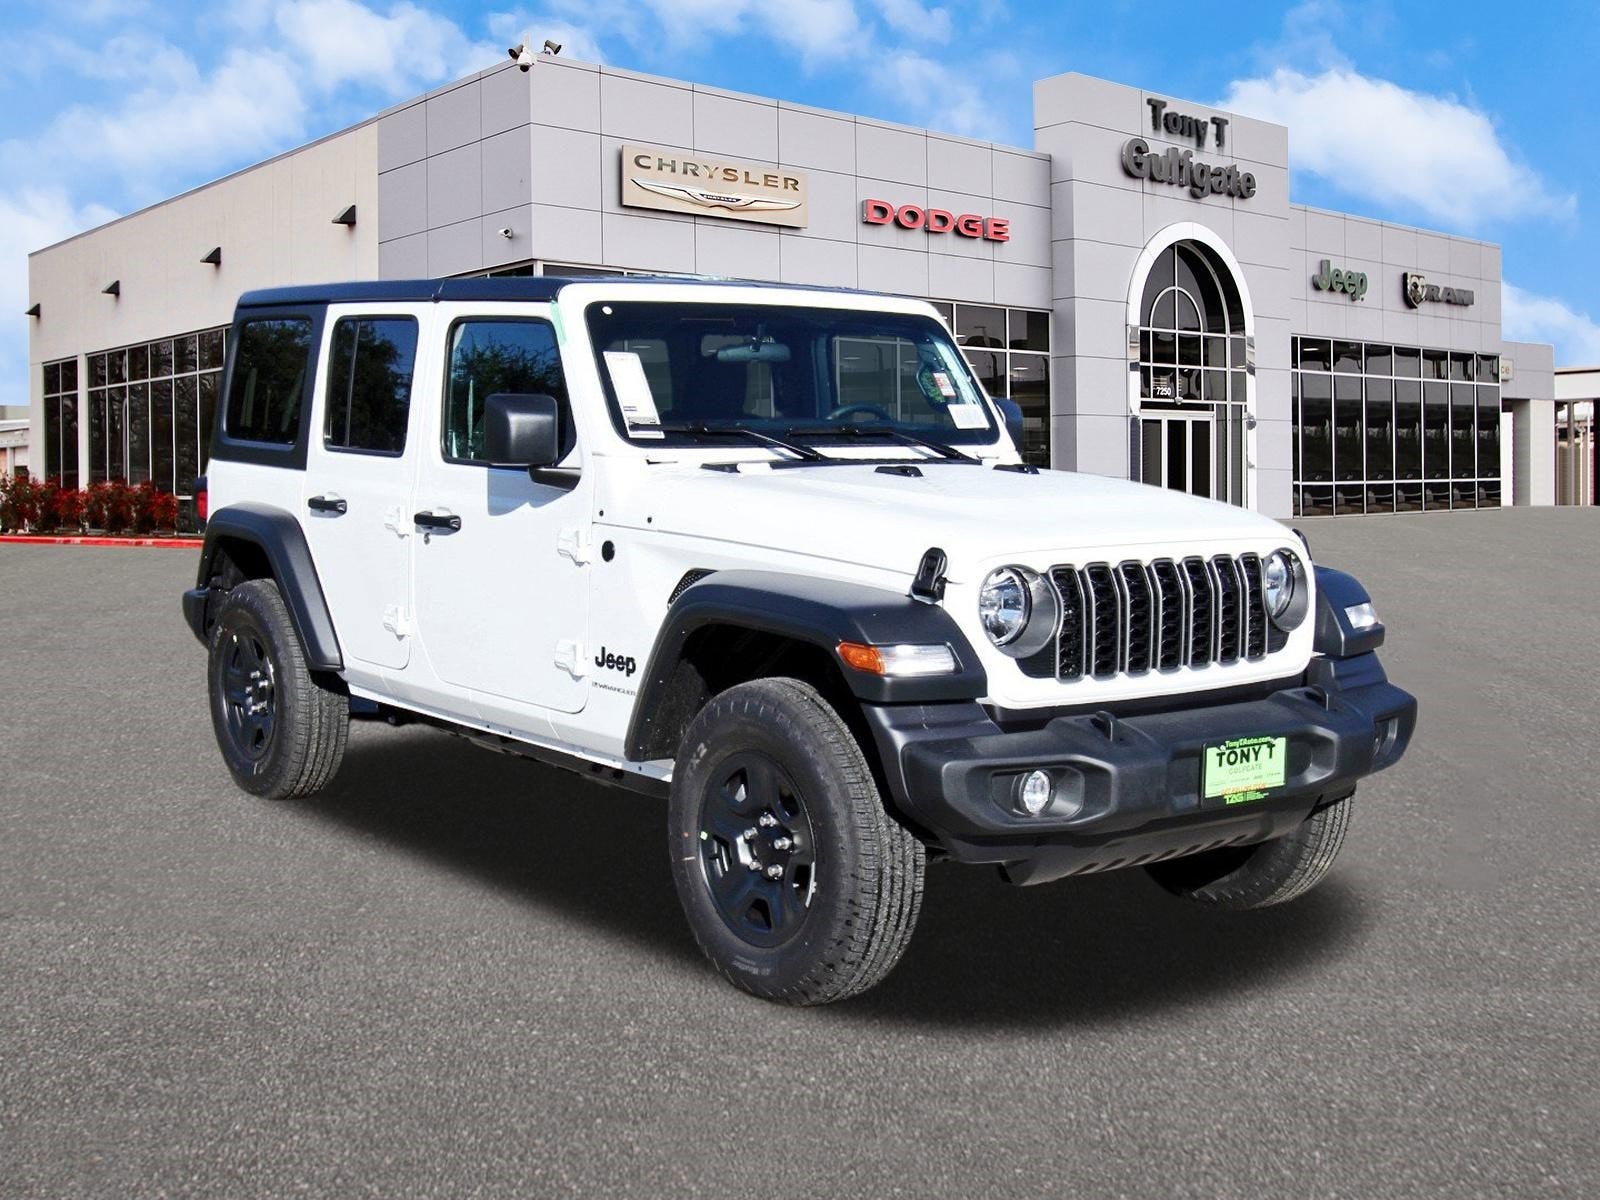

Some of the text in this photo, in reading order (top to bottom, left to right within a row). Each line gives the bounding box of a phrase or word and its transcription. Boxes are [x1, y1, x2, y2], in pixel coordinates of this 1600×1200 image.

[1147, 98, 1228, 148] Tony T
[633, 153, 800, 192] CHRYSLER
[1121, 138, 1257, 199] Gulfgate
[862, 198, 1010, 243] DODGE
[1312, 259, 1368, 302] Jeep
[1425, 284, 1475, 307] RAM
[1156, 386, 1172, 396] 7250
[595, 646, 636, 677] Jeep
[1216, 742, 1276, 768] TONY T
